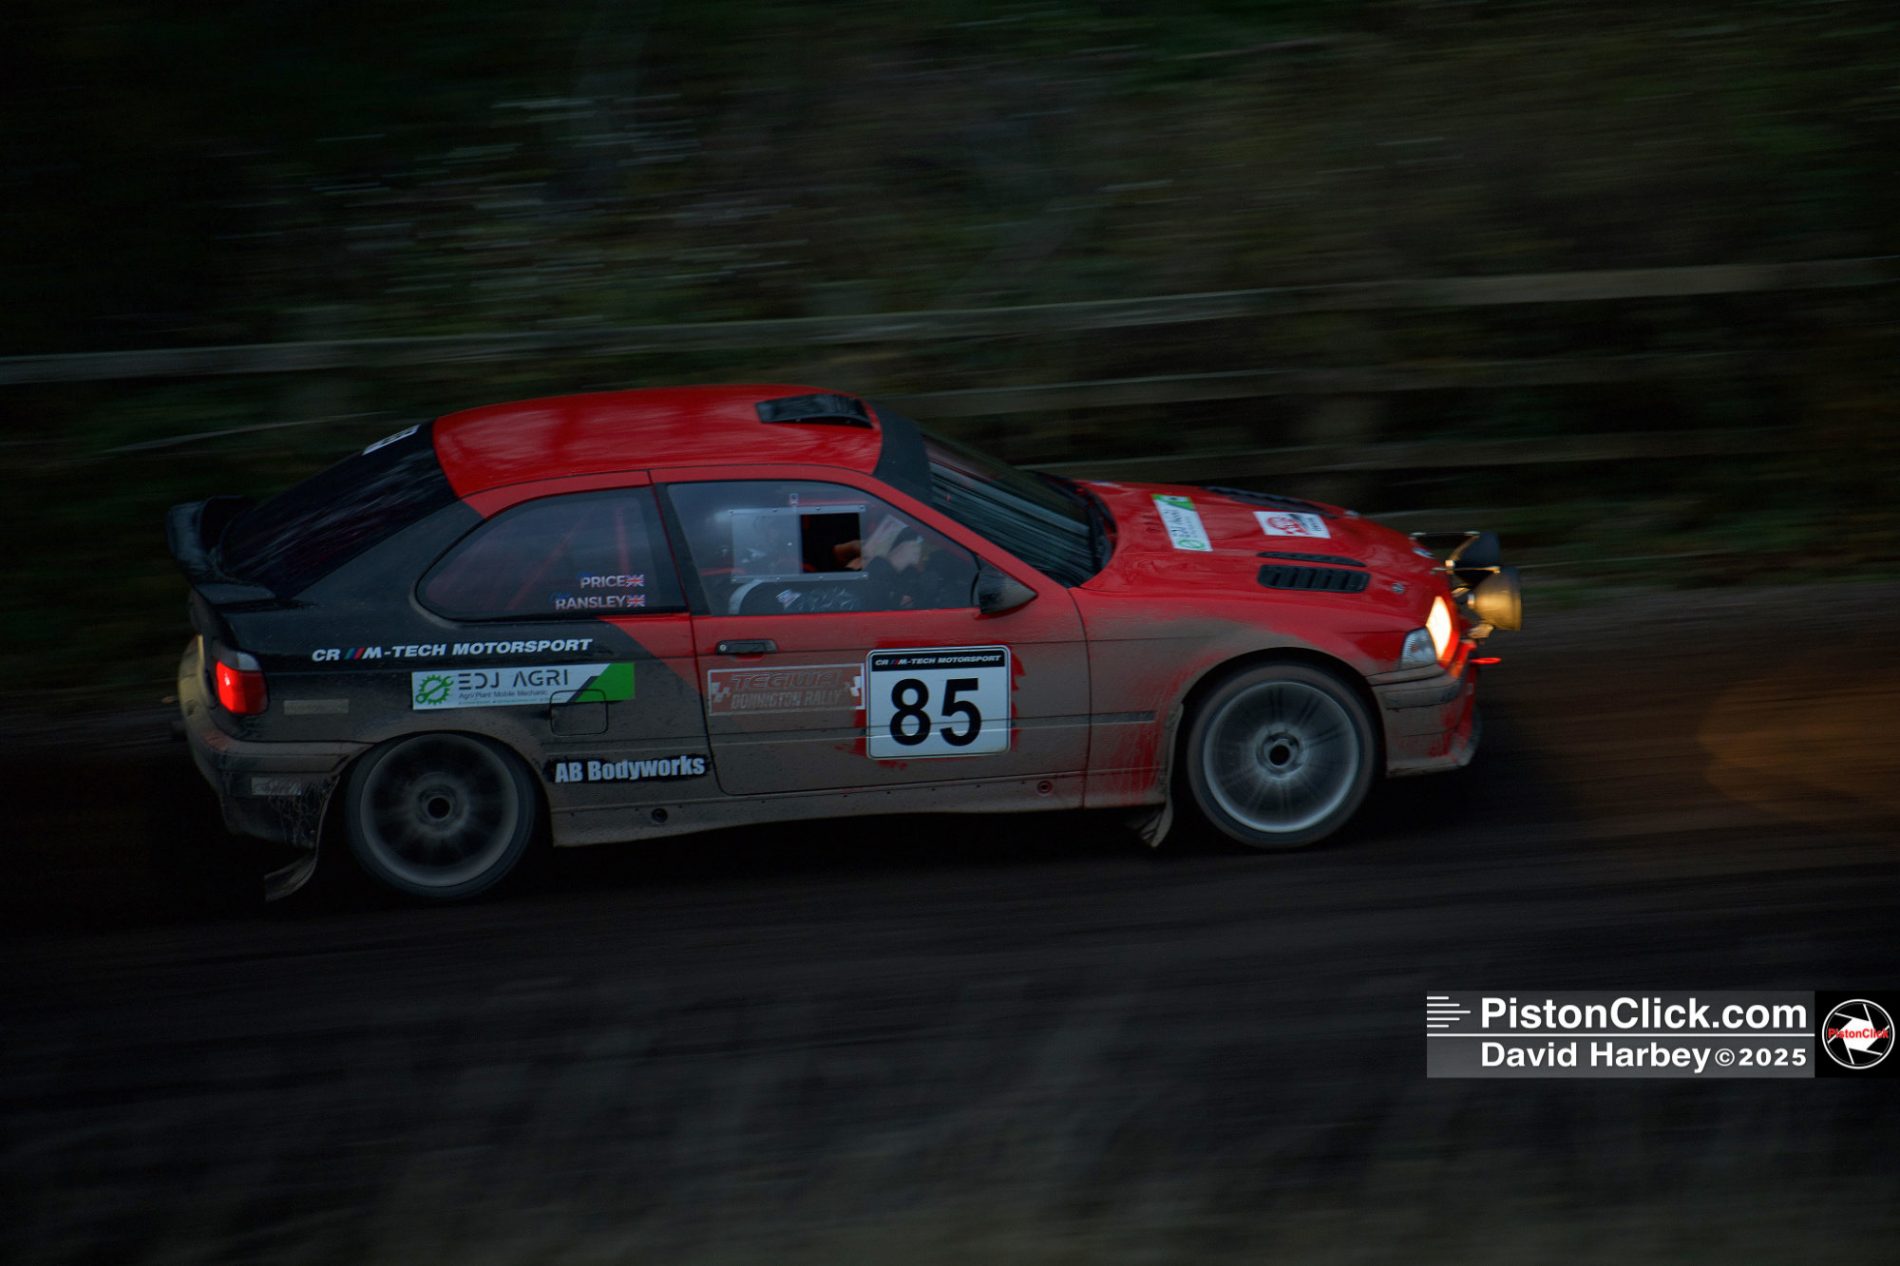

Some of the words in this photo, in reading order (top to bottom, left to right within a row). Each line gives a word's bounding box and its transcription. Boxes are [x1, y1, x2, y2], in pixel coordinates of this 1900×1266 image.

[581, 575, 625, 588] PRICE
[555, 595, 626, 610] RANSLEY
[312, 648, 340, 662] CR
[452, 638, 593, 656] MOTORSPORT
[937, 654, 1002, 664] MOTORSPORT
[458, 672, 499, 690] EDJ
[513, 669, 568, 687] AGRI
[804, 689, 842, 706] RALLY
[889, 678, 982, 746] 85
[555, 760, 583, 783] AB
[587, 754, 706, 782] Bodyworks
